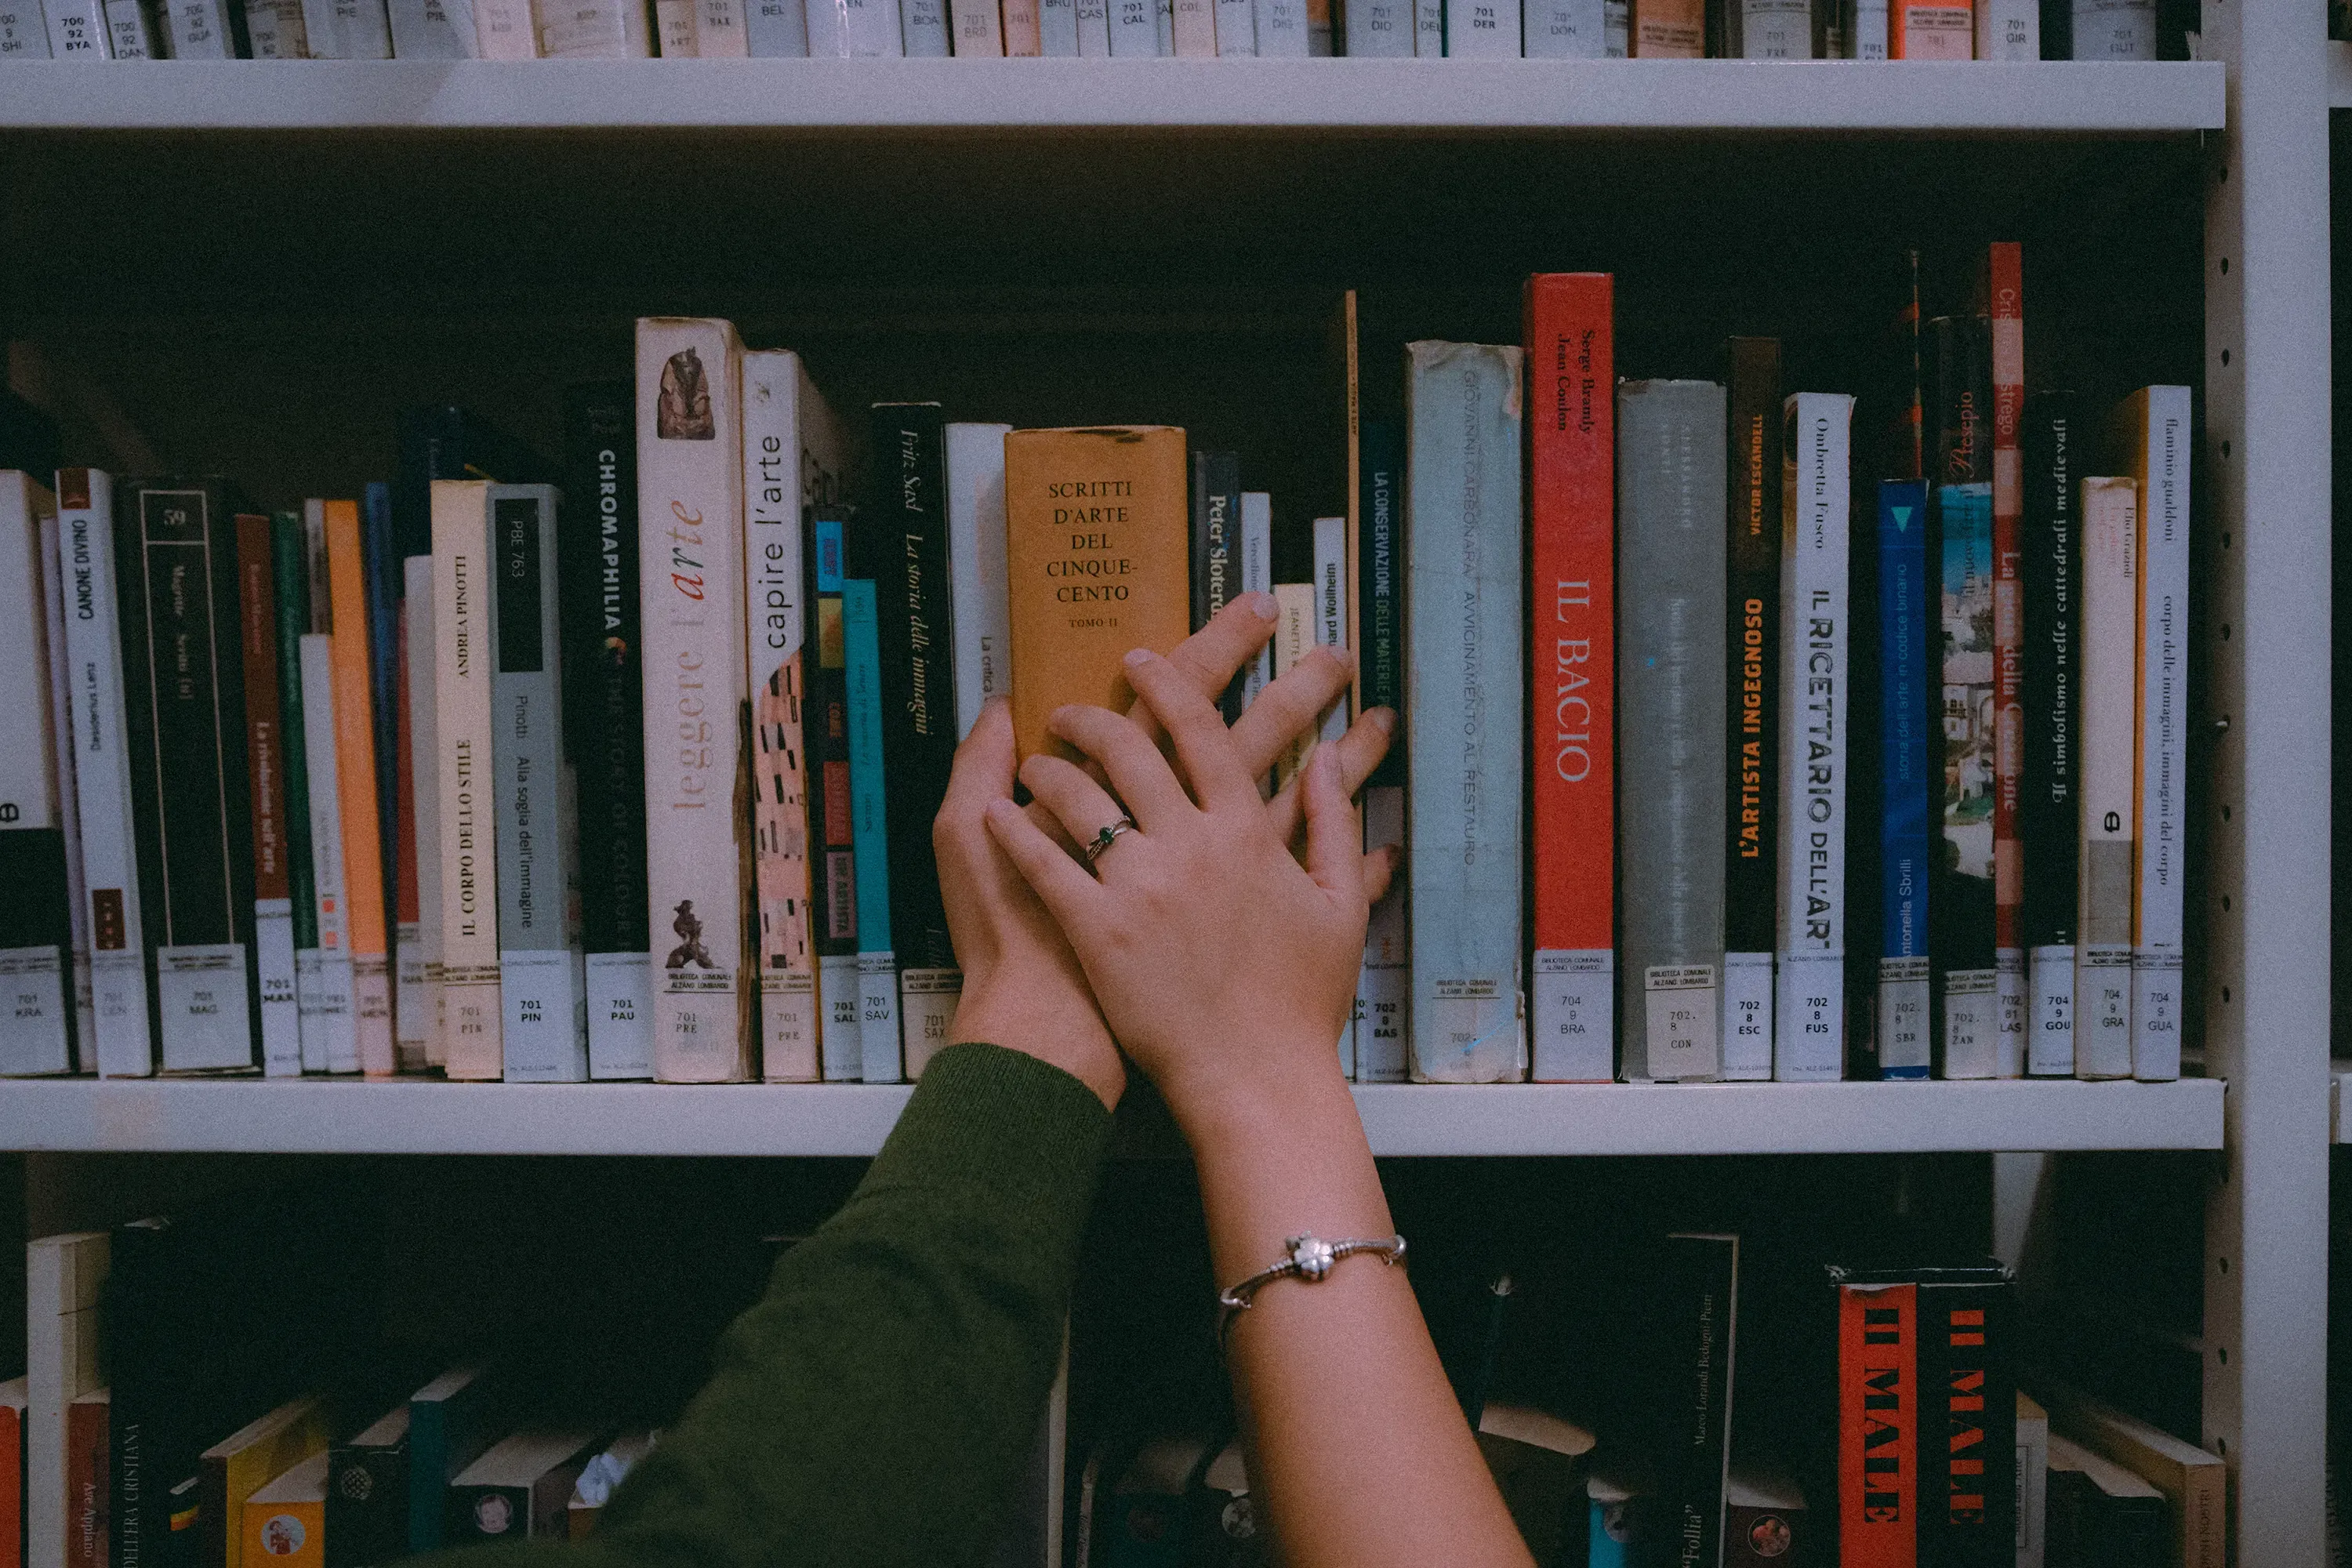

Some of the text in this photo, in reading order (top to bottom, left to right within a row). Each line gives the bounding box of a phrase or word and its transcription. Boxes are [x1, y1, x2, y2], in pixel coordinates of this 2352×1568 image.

[761, 5, 785, 16] BEL
[1079, 9, 1103, 20] CAS
[1123, 2, 1143, 13] 701
[1475, 7, 1494, 17] 701
[60, 17, 85, 27] 700
[1122, 14, 1145, 25] CAL
[1473, 20, 1496, 29] DER
[67, 29, 84, 39] 92
[1550, 25, 1577, 36] DON
[65, 41, 92, 51] BYA
[1556, 334, 1571, 431] Jean Coulon
[1578, 328, 1595, 434] Serge Bramly
[1949, 391, 1980, 478] Presepio
[900, 429, 919, 469] Fritz
[2165, 418, 2179, 477] flaminio
[2053, 418, 2067, 511] medievali
[1048, 481, 1132, 499] SCRITTI
[1814, 417, 1831, 550] Ombretta Fusco
[1054, 506, 1131, 525] D'ARTE
[1208, 494, 1228, 542] Peter
[2162, 479, 2178, 542] gualdoni
[599, 449, 622, 630] CHROMAPHILIA
[755, 436, 793, 651] l'arte capire
[906, 533, 924, 560] La
[1071, 533, 1113, 550] DEL
[71, 519, 95, 620] CANONE DIVINO
[1046, 558, 1139, 579] CINQUE-
[2053, 519, 2067, 613] cattedrali
[907, 564, 927, 611] storia
[1374, 472, 1390, 690] LA CONSERVAZIONE DELLE MATERIE
[1055, 586, 1130, 603] CENTO
[1324, 563, 1338, 618] Wollheim
[455, 555, 472, 680] ANDREA PINOTTI
[1068, 617, 1105, 629] TOMO
[1463, 370, 1476, 866] GIOVANNI CARBONARA AVVICINAMENTO AL RESTAURO
[2002, 553, 2024, 696] La della
[2161, 595, 2173, 636] corpo
[909, 615, 930, 652] delle
[1289, 607, 1301, 656] JEANETTE
[2053, 619, 2067, 666] nelle
[980, 636, 994, 694] La critica
[2162, 639, 2176, 673] delle
[1894, 563, 1911, 779] binario codice in arte storia
[1555, 579, 1592, 783] IL BACIO
[1806, 590, 1833, 823] IL RICETTARIO
[510, 520, 535, 928] PBE 763 Pinotti Alla soglia dell'immagine
[670, 650, 713, 811] leggere
[1738, 598, 1763, 858] INGEGNOSO L'ARTISTA
[2052, 672, 2067, 775] simbolismo
[2158, 751, 2174, 816] immagini
[456, 739, 477, 938] STILE DELLO CORPO IL
[2160, 820, 2173, 841] del
[2157, 844, 2169, 886] corpo
[1898, 858, 1913, 897] Sbrilli
[519, 1000, 543, 1011] 701
[610, 999, 634, 1010] 701
[833, 1001, 856, 1011] 701
[866, 996, 887, 1007] 701
[1561, 995, 1581, 1006] 704
[1738, 1000, 1761, 1011] 702
[1806, 996, 1829, 1008] 702
[2046, 995, 2069, 1006] 704
[2149, 992, 2169, 1004] 704
[610, 1011, 636, 1022] PAU
[676, 1011, 697, 1022] 701
[864, 1010, 890, 1021] SAV
[1374, 1003, 1397, 1013] 702
[1569, 1009, 1577, 1020] 9
[1813, 1010, 1821, 1020] 8
[2054, 1007, 2063, 1018] 9
[2108, 1002, 2116, 1014] 9
[2156, 1006, 2164, 1018] 9
[520, 1013, 543, 1023] PIN
[924, 1014, 945, 1026] 701
[1670, 1021, 1678, 1032] 8
[1745, 1013, 1753, 1023] 8
[2044, 1020, 2071, 1031] GOU
[2100, 1016, 2125, 1029] GRA
[2147, 1019, 2173, 1032] GUA
[1374, 1028, 1399, 1038] BAS
[1559, 1023, 1586, 1034] BRA
[1737, 1025, 1761, 1036] ESC
[1805, 1023, 1829, 1034] FUS
[1999, 1022, 2022, 1034] LAS
[1670, 1039, 1692, 1049] CON
[1864, 1367, 1900, 1524] MALE
[1949, 1369, 1985, 1524] MALE
[122, 1424, 140, 1502] CRISTIANA
[82, 1481, 97, 1504] Ave
